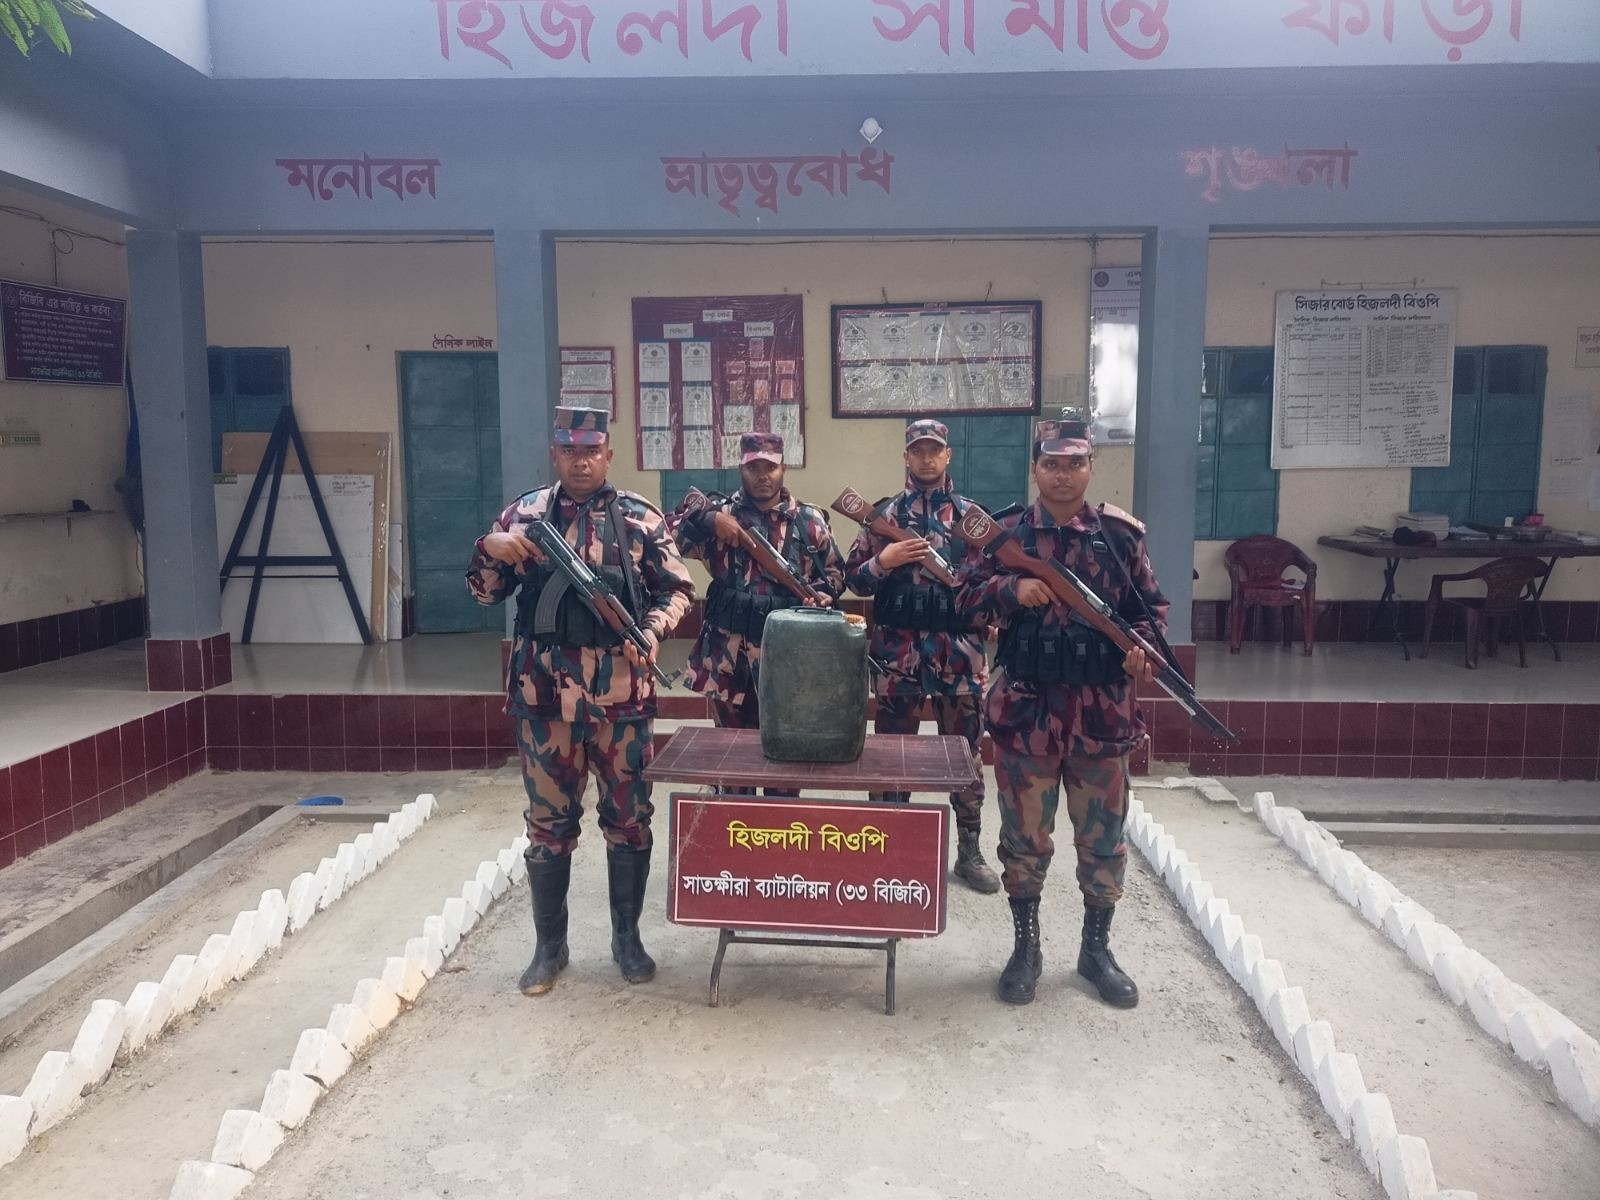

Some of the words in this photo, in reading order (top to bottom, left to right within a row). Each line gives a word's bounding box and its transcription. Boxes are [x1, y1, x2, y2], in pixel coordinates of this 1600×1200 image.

[275, 152, 442, 201] মনোবল
[660, 147, 895, 218] ভ্রাতৃত্ববোধ
[1357, 293, 1401, 311] হিজলদী
[1403, 293, 1440, 310] বিওপি
[726, 820, 813, 851] হিজলদী
[818, 824, 889, 855] বিওপি
[682, 870, 751, 898] সাতক্ষীরা
[754, 873, 831, 900] ব্যাটালিয়ন
[836, 880, 868, 906] (৩৩
[872, 878, 931, 910] বিজিবি)
